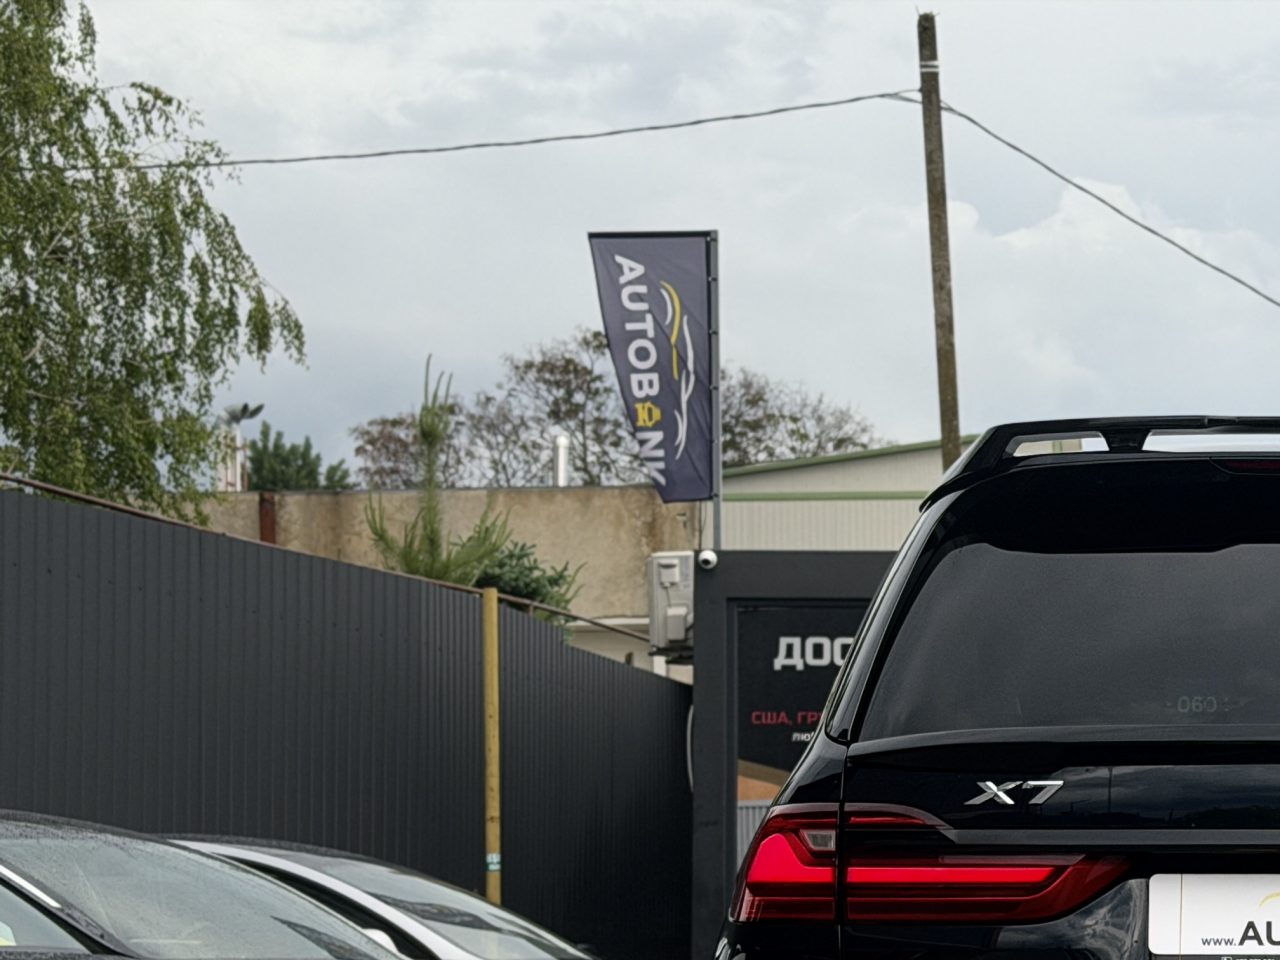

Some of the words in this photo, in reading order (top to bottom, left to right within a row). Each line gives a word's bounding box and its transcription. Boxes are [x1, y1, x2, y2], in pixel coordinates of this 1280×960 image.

[751, 711, 793, 726] США,
[797, 711, 823, 725] ГР
[964, 779, 1064, 805] X7
